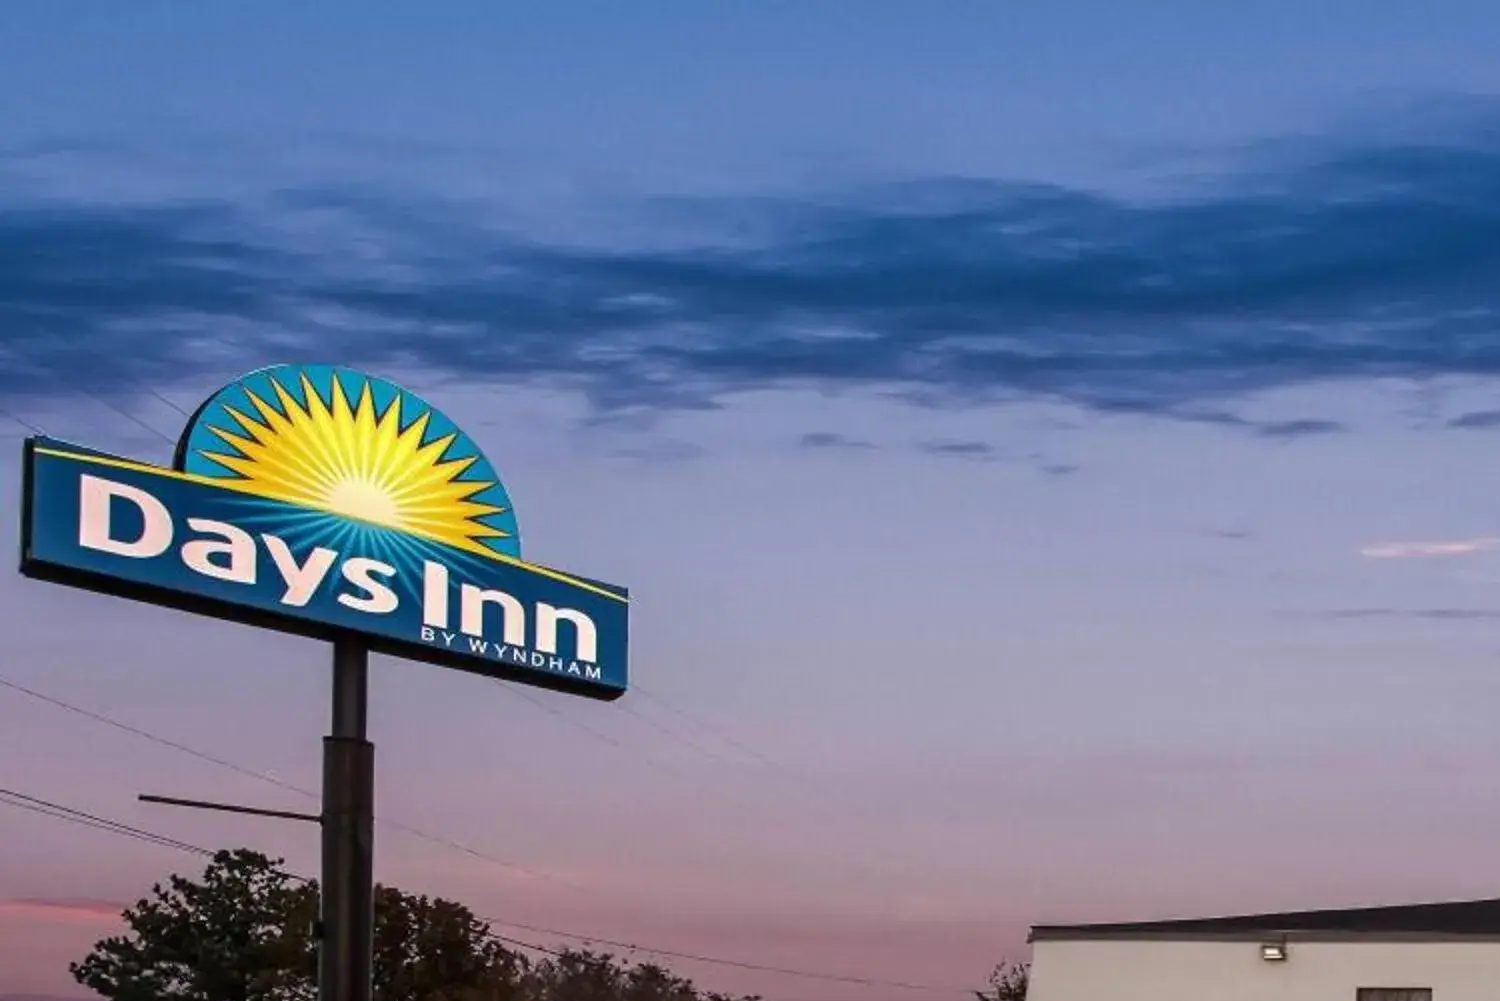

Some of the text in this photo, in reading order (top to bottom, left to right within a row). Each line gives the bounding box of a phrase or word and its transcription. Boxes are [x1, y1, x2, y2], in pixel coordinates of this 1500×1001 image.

[79, 473, 597, 664] Days Inn
[421, 626, 601, 680] BY WYNDHAM
